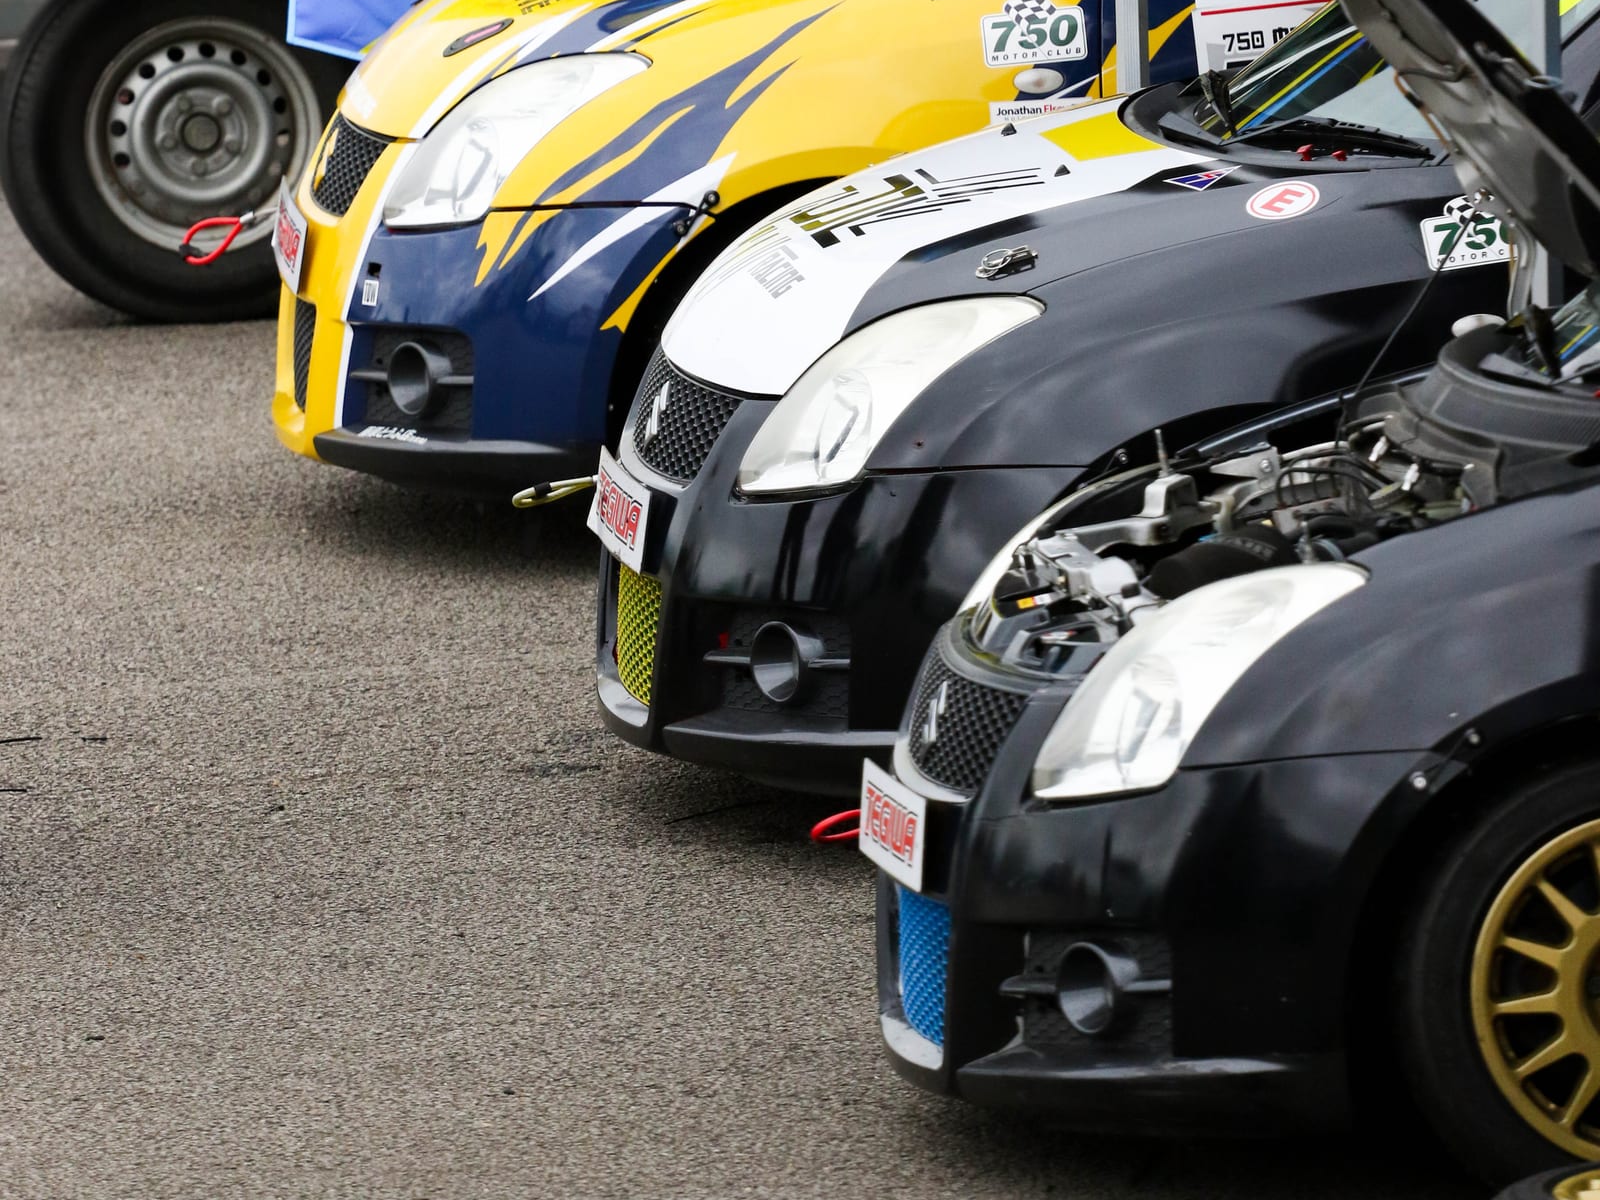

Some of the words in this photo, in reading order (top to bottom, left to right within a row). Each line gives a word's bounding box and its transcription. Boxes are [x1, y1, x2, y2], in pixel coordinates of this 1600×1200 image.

[991, 13, 1079, 53] 750
[1222, 30, 1265, 52] 750
[992, 51, 1038, 62] MOTOR
[1047, 47, 1082, 56] CLUB
[996, 105, 1043, 116] Jonathan
[1259, 188, 1305, 214] E
[598, 469, 643, 548] TEGIWA
[865, 785, 918, 862] TEGIWA
